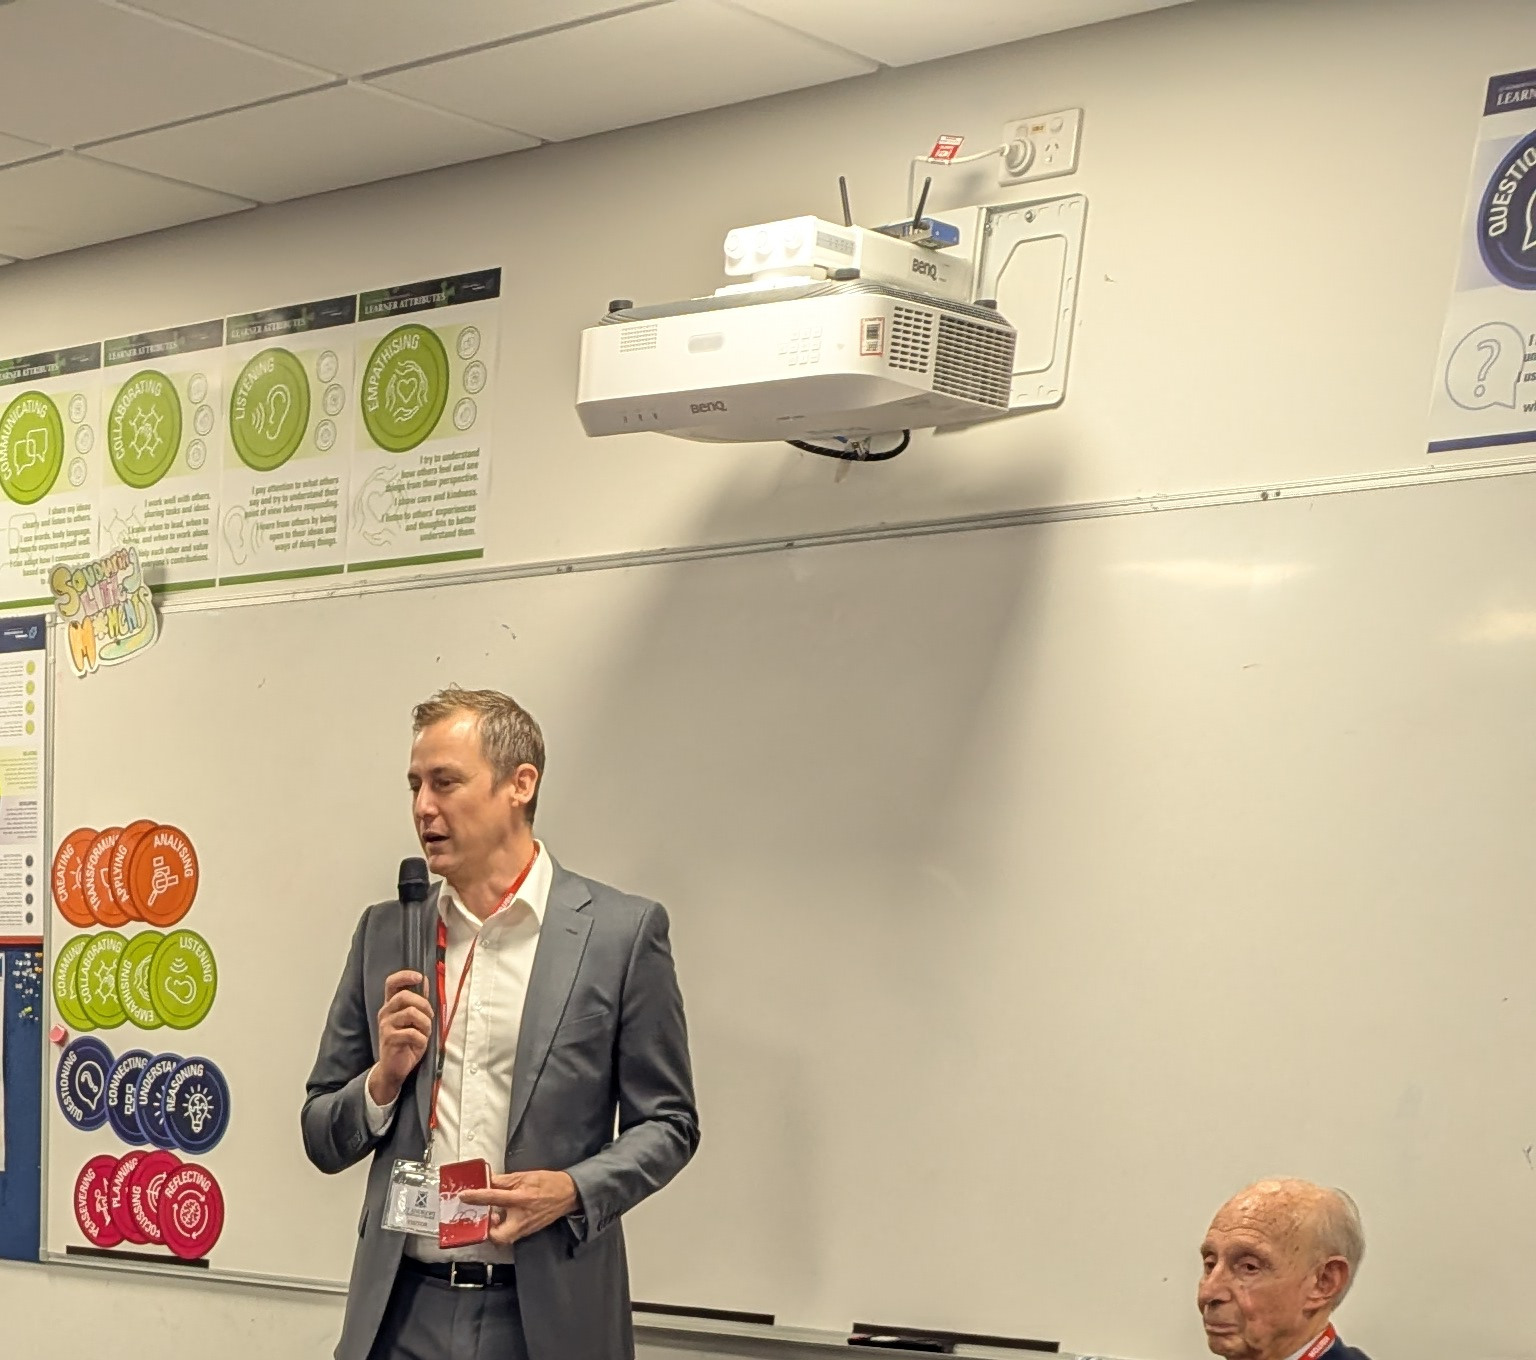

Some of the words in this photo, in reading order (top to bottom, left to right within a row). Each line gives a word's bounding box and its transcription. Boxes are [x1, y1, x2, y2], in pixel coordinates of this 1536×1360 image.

[912, 258, 937, 281] BenQ
[235, 357, 274, 420] LISTENING
[368, 334, 420, 412] EMPATHISING
[113, 379, 163, 460] COLLABORATING
[691, 400, 727, 414] BenQ
[0, 399, 48, 481] COMMUNICATING
[56, 843, 75, 903] CREATING
[113, 845, 129, 903] APPLYING
[153, 833, 194, 878] ANALYSING
[80, 936, 124, 1004] COLLABORATING
[179, 936, 213, 983] LISTENING
[120, 959, 154, 1022] EMPATHISING
[60, 1051, 84, 1122] QUESTIONING
[166, 1064, 205, 1112] REASONING
[78, 1168, 100, 1238] PERSEVERING
[112, 1157, 138, 1208] PLANNING
[132, 1185, 161, 1238] FOCUSSING
[164, 1171, 212, 1199] REFLECTING
